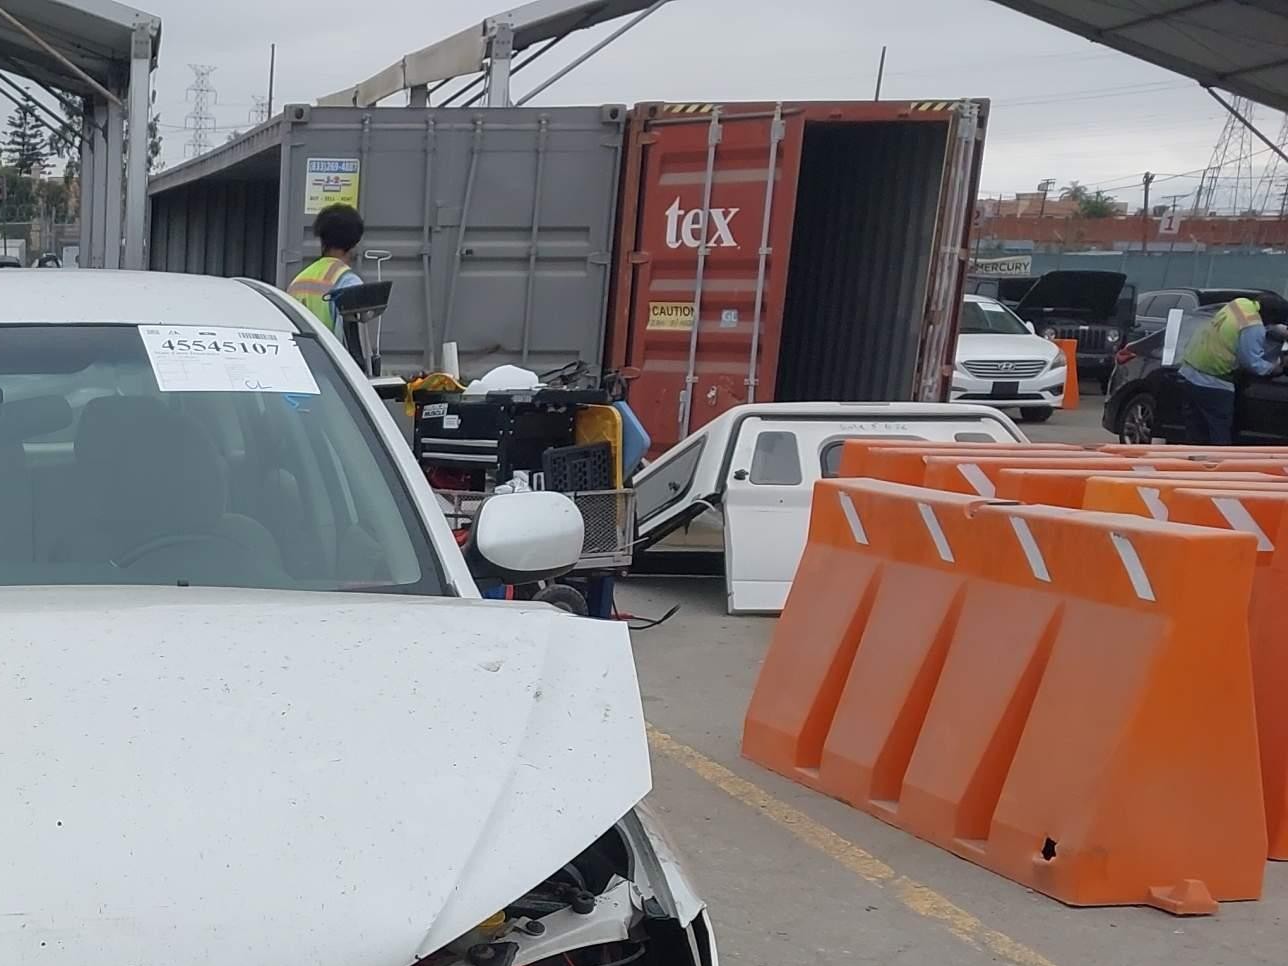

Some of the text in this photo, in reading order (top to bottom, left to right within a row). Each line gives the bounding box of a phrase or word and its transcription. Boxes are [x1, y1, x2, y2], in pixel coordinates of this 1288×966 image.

[664, 195, 740, 249] tex
[1164, 215, 1174, 231] 1
[976, 261, 1030, 274] MERCURY
[162, 339, 279, 356] 45545107
